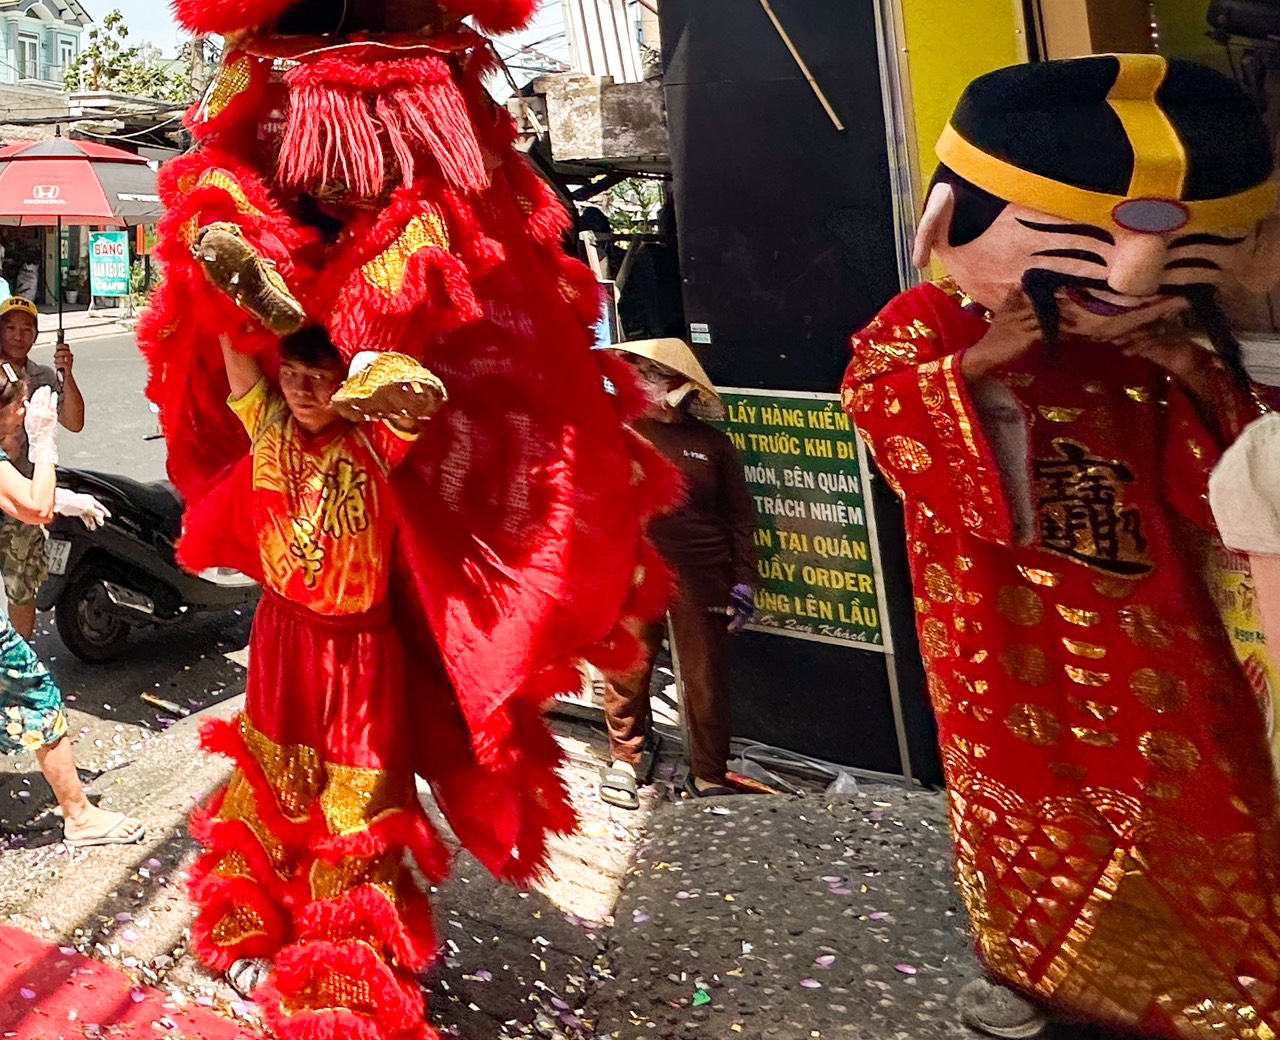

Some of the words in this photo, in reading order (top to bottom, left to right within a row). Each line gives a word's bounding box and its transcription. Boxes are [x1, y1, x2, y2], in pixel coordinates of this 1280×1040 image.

[728, 399, 756, 424] LẤY
[761, 403, 805, 428] HÀNG
[807, 402, 850, 431] KIỂM
[748, 431, 800, 456] TRƯỚC
[804, 438, 832, 458] KHI
[836, 440, 855, 460] ĐI
[744, 462, 780, 489] MÓN,
[783, 465, 815, 489] BÊN
[818, 470, 859, 494] QUÁN
[754, 494, 806, 518] TRÁCH
[810, 501, 864, 527] NHIỆM
[776, 531, 808, 555] TẠI
[813, 535, 867, 561] QUÁN
[758, 553, 795, 582] UẦY
[802, 566, 873, 594] ORDER
[794, 593, 833, 620] LÊN
[838, 597, 877, 627] LẦU
